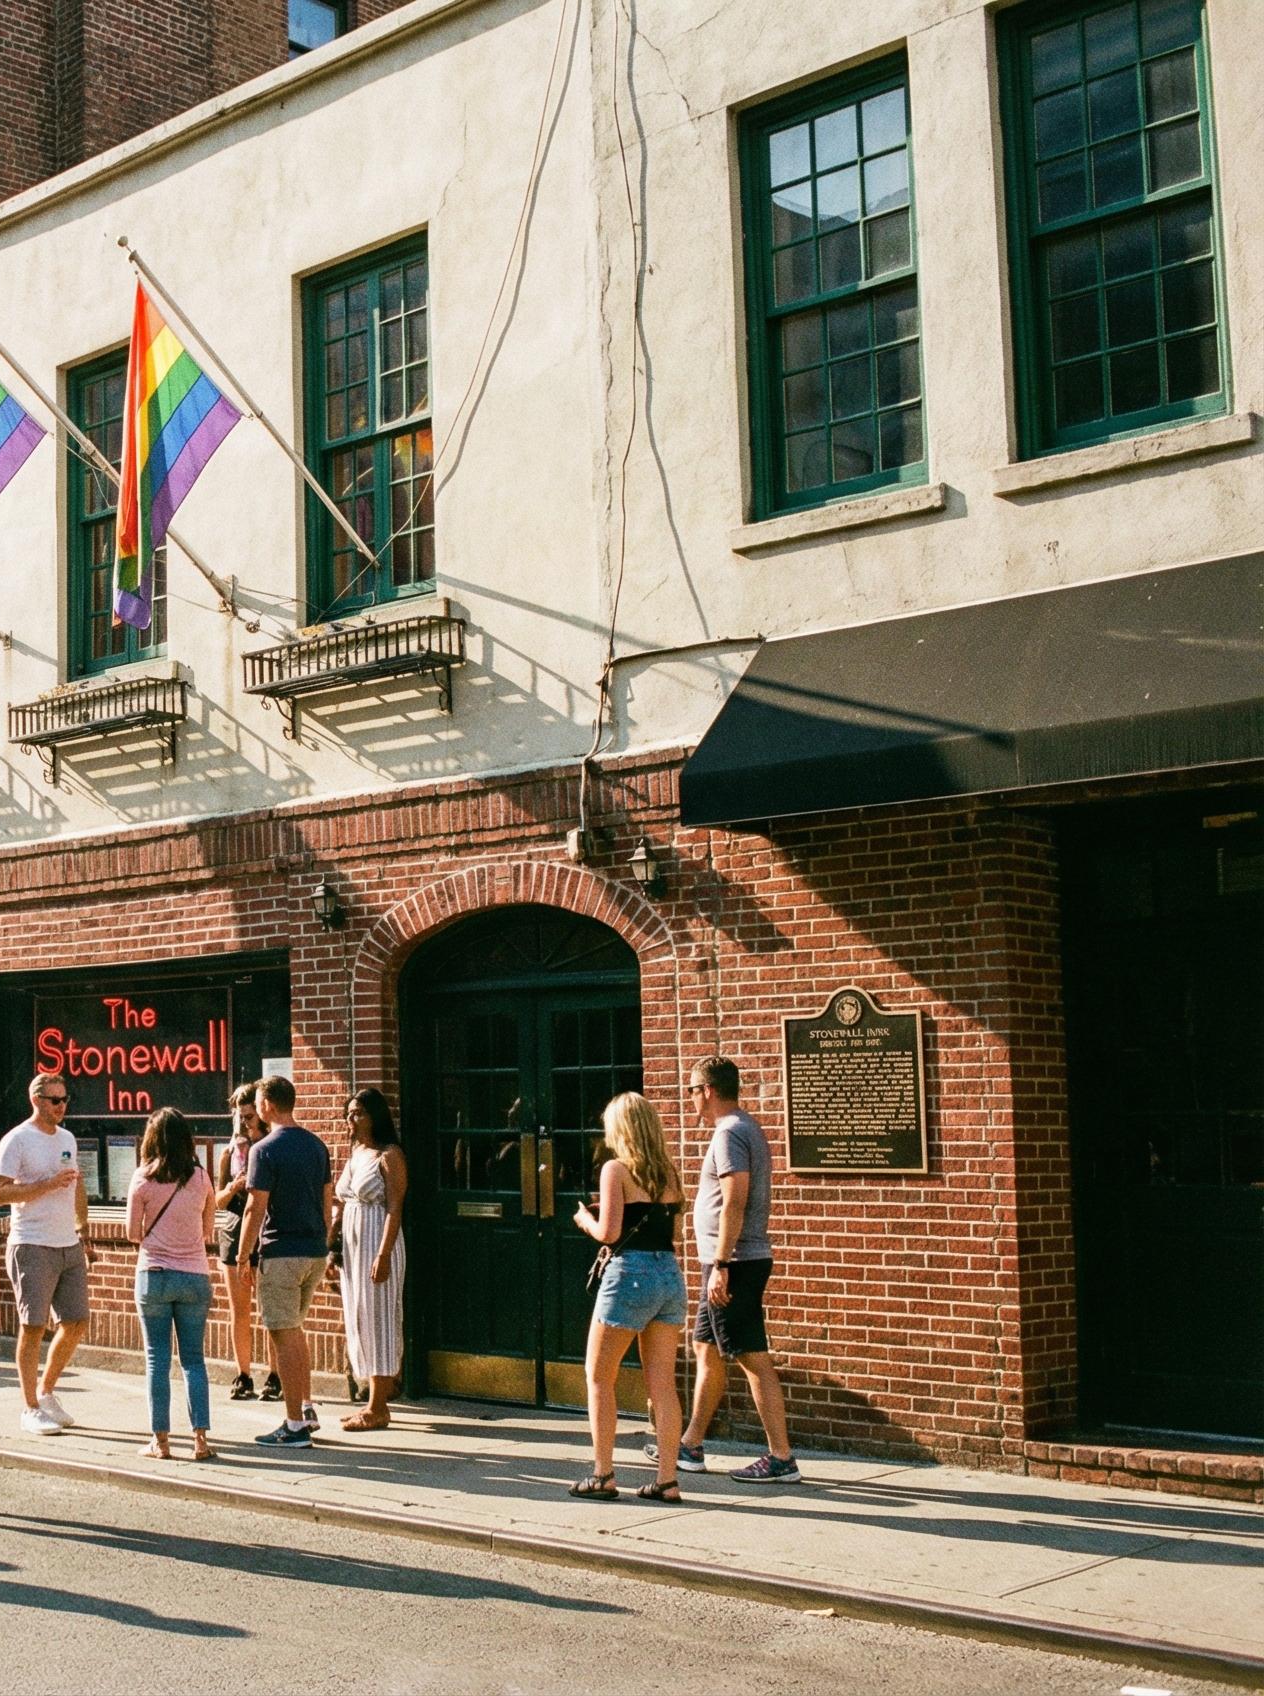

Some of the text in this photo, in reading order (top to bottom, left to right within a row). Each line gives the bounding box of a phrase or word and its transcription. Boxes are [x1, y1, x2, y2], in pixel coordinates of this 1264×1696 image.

[103, 998, 157, 1029] The
[37, 1019, 228, 1076] Stonewall
[108, 1080, 152, 1111] Inn
